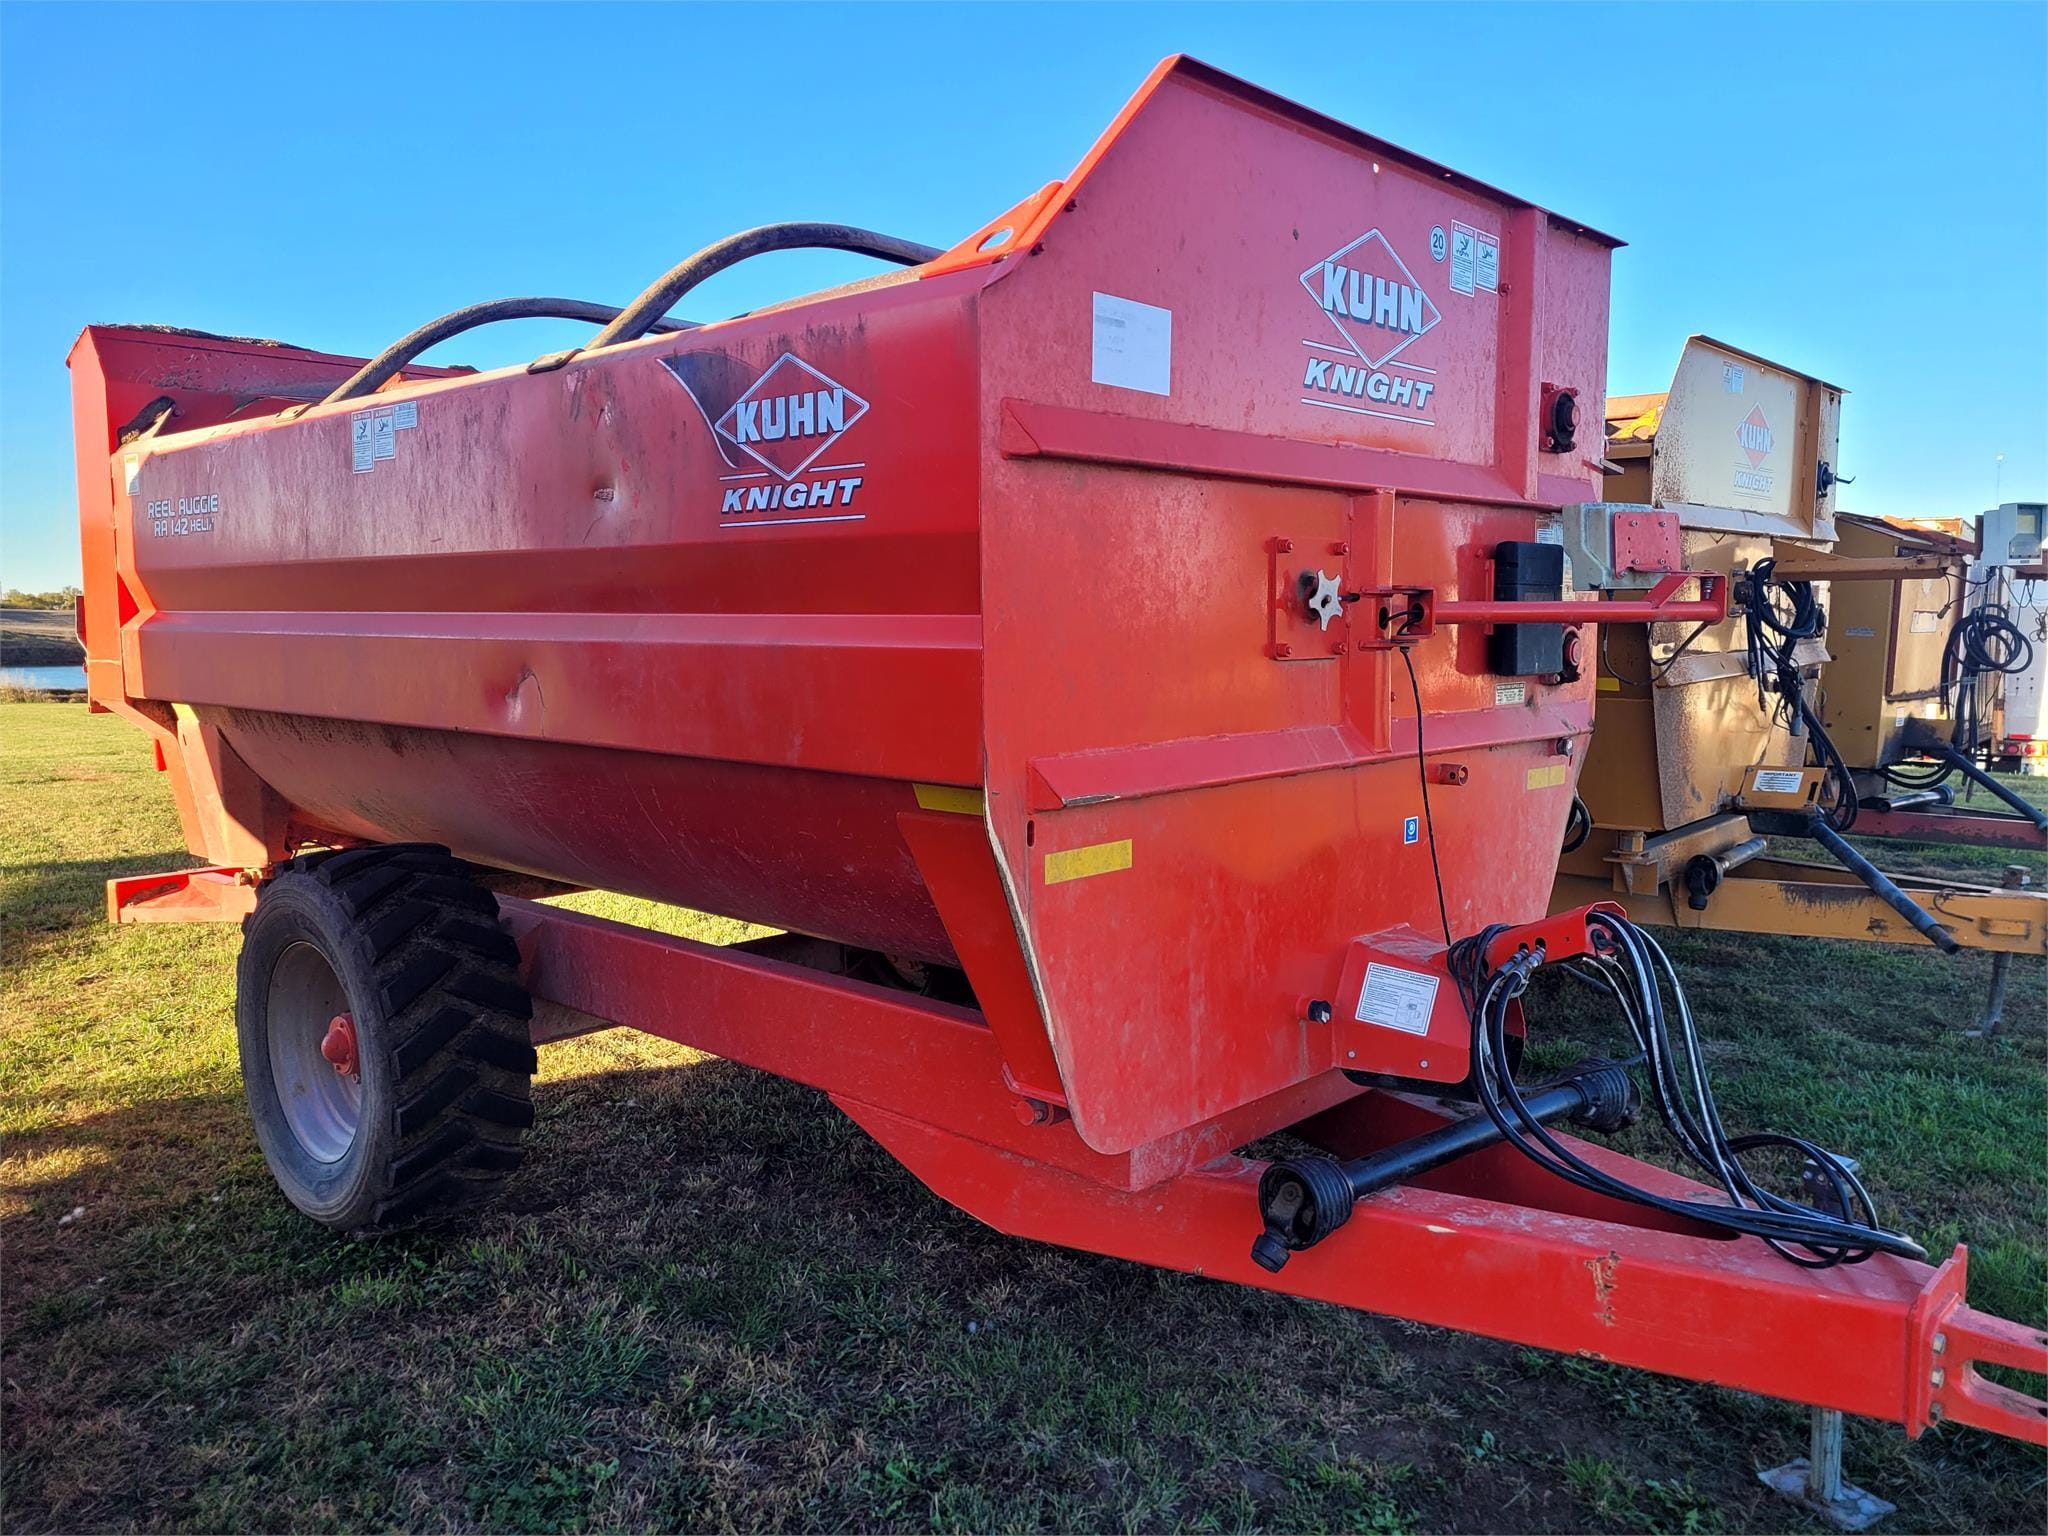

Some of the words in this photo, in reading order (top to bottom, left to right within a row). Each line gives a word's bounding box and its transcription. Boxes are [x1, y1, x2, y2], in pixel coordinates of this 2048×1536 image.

[1432, 233, 1445, 250] 20
[1323, 261, 1424, 336] KUHN
[1303, 357, 1434, 409] KNIGHT
[736, 387, 844, 444] KUHN
[1740, 423, 1773, 453] KUHN
[721, 477, 863, 514] KNIGHT
[1734, 470, 1773, 493] KNIGHT
[147, 500, 176, 519] REEL
[178, 494, 219, 516] AUGGIE
[154, 520, 168, 537] RA
[171, 518, 188, 536] 142
